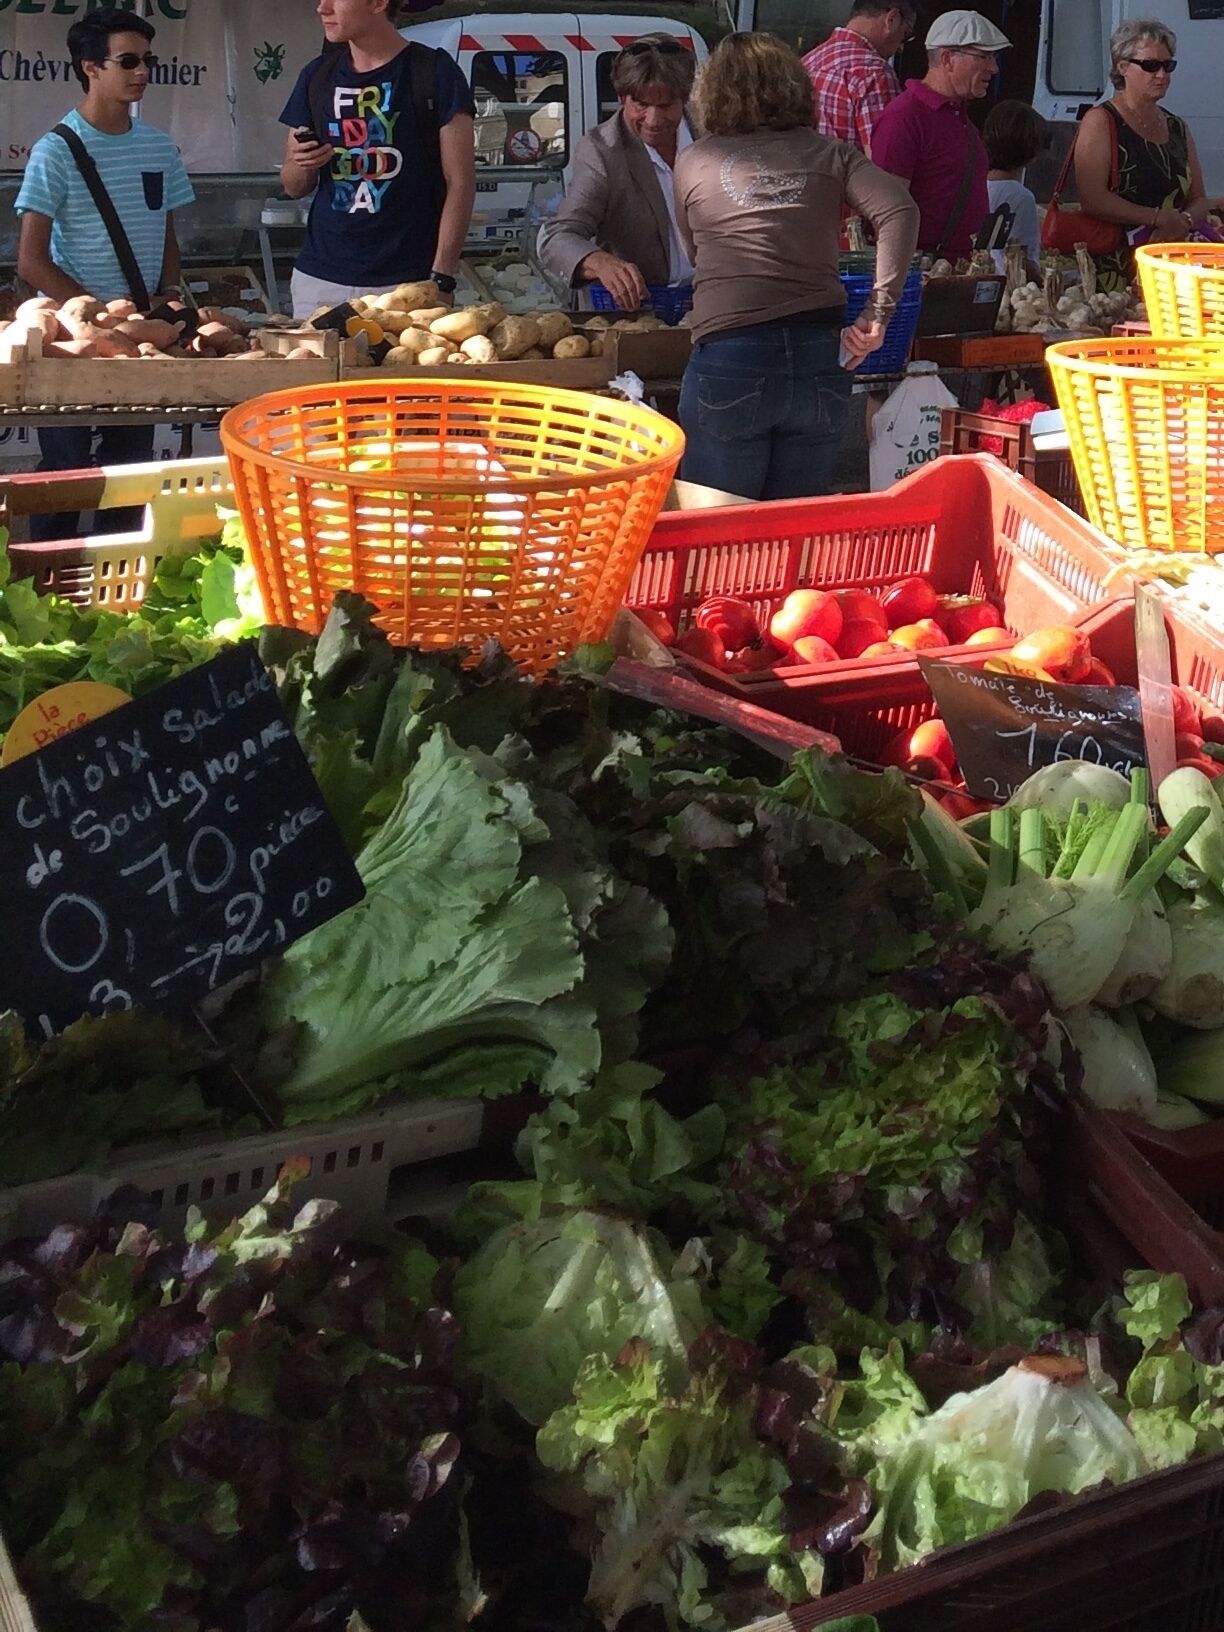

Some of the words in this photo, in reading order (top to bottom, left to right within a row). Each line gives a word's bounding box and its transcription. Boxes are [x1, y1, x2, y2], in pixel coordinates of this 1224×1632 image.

[334, 82, 392, 119] FRI
[331, 147, 403, 180] GOOD
[331, 180, 392, 214] DAY
[36, 702, 61, 722] la
